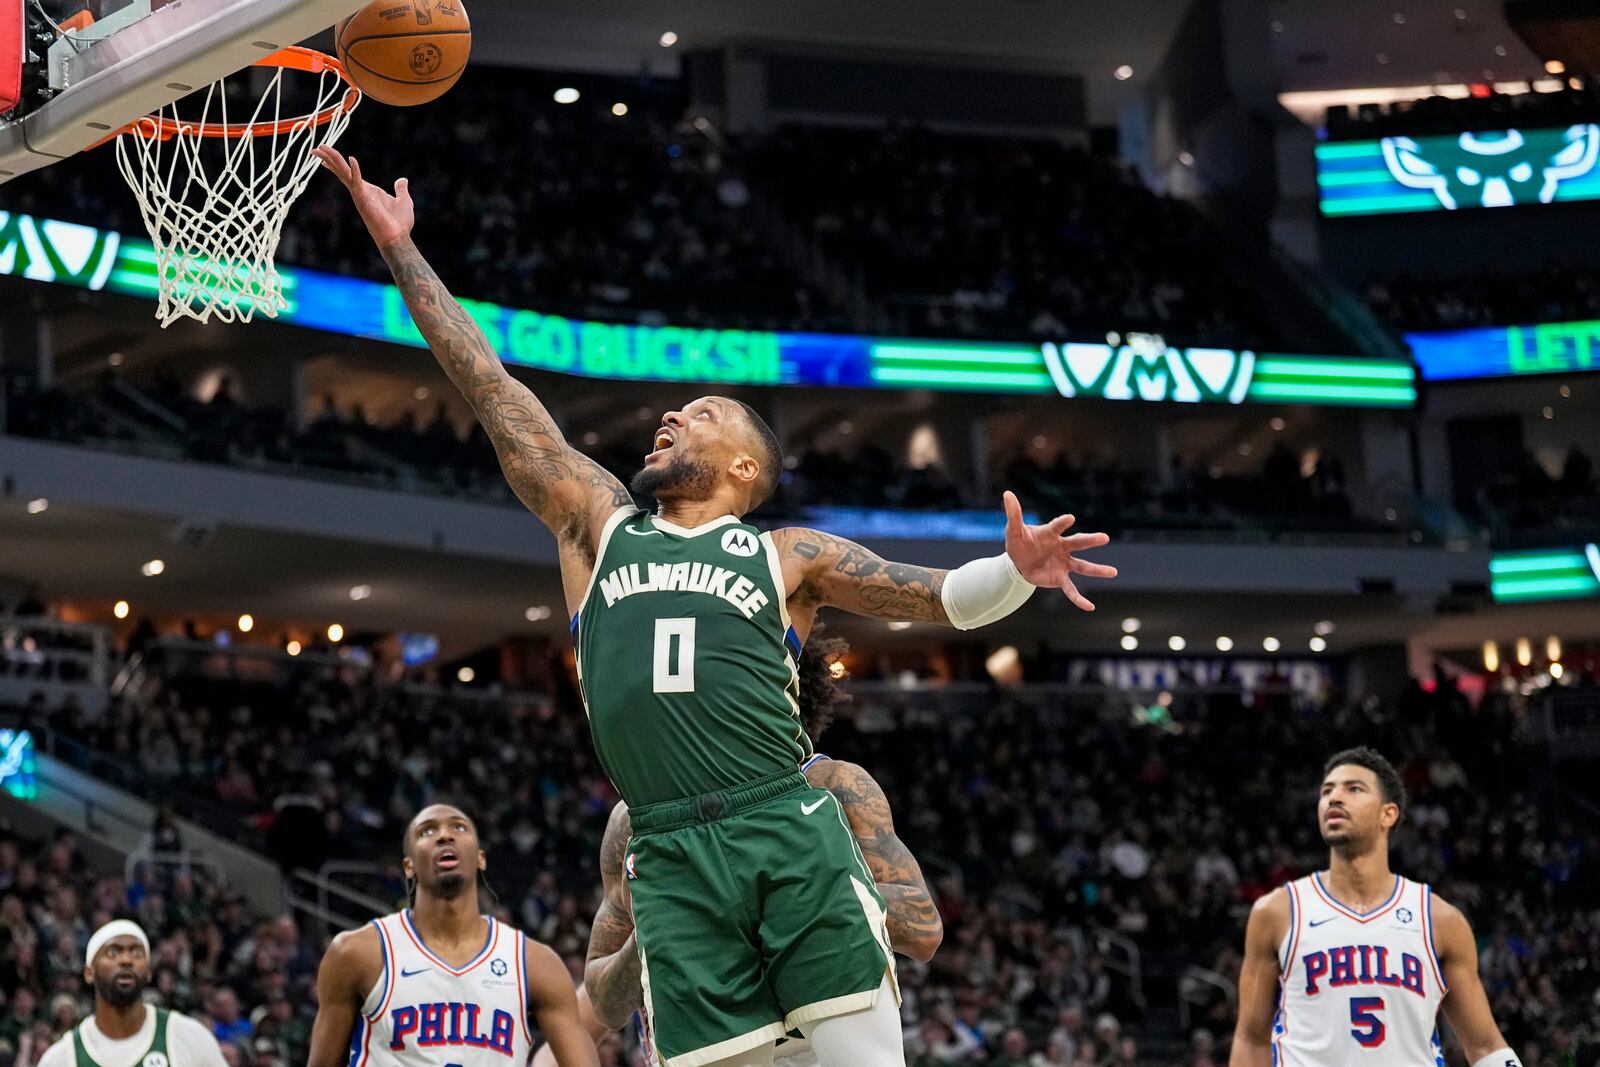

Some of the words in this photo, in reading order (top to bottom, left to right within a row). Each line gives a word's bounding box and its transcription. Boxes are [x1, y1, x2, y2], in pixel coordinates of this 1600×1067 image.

[509, 309, 574, 368] GO
[599, 561, 769, 619] MILWAUKEE
[653, 617, 696, 693] 0
[1303, 945, 1425, 998] PHILA
[390, 1002, 515, 1057] PHILA
[1349, 997, 1386, 1047] 5
